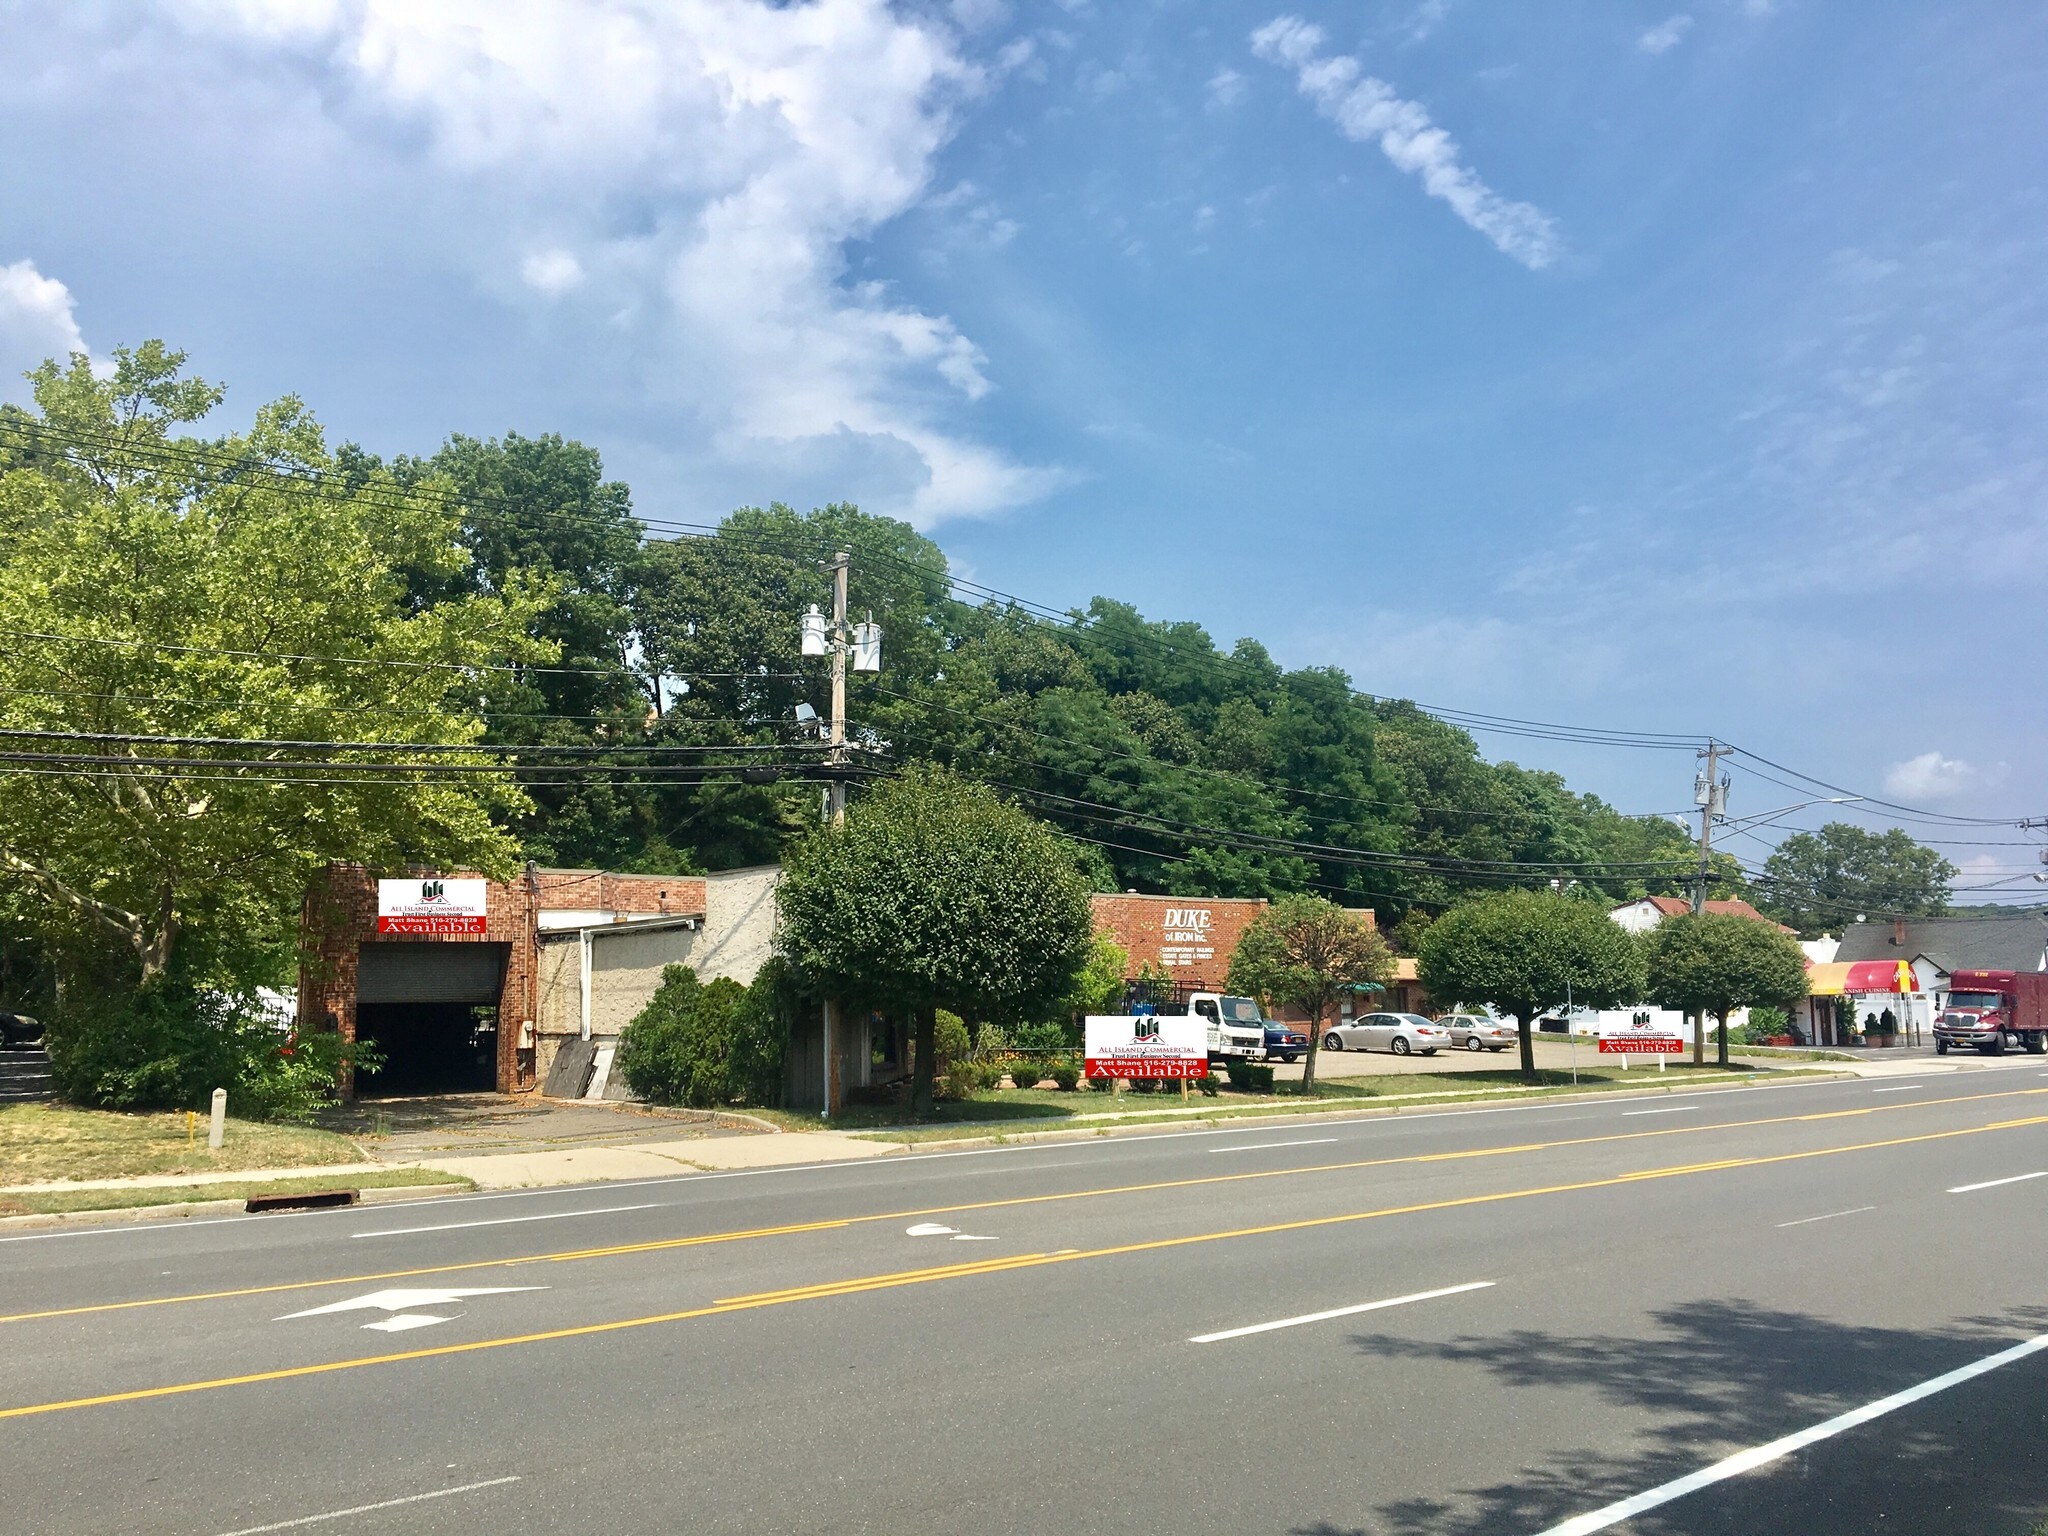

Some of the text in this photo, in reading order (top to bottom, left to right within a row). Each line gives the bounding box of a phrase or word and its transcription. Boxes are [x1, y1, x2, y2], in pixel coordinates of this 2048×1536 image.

[1163, 908, 1212, 931] DUKE
[384, 922, 481, 932] Available
[1165, 932, 1207, 942] of IRON Inc.
[1603, 1044, 1679, 1052] Available
[1091, 1066, 1201, 1076] Available
